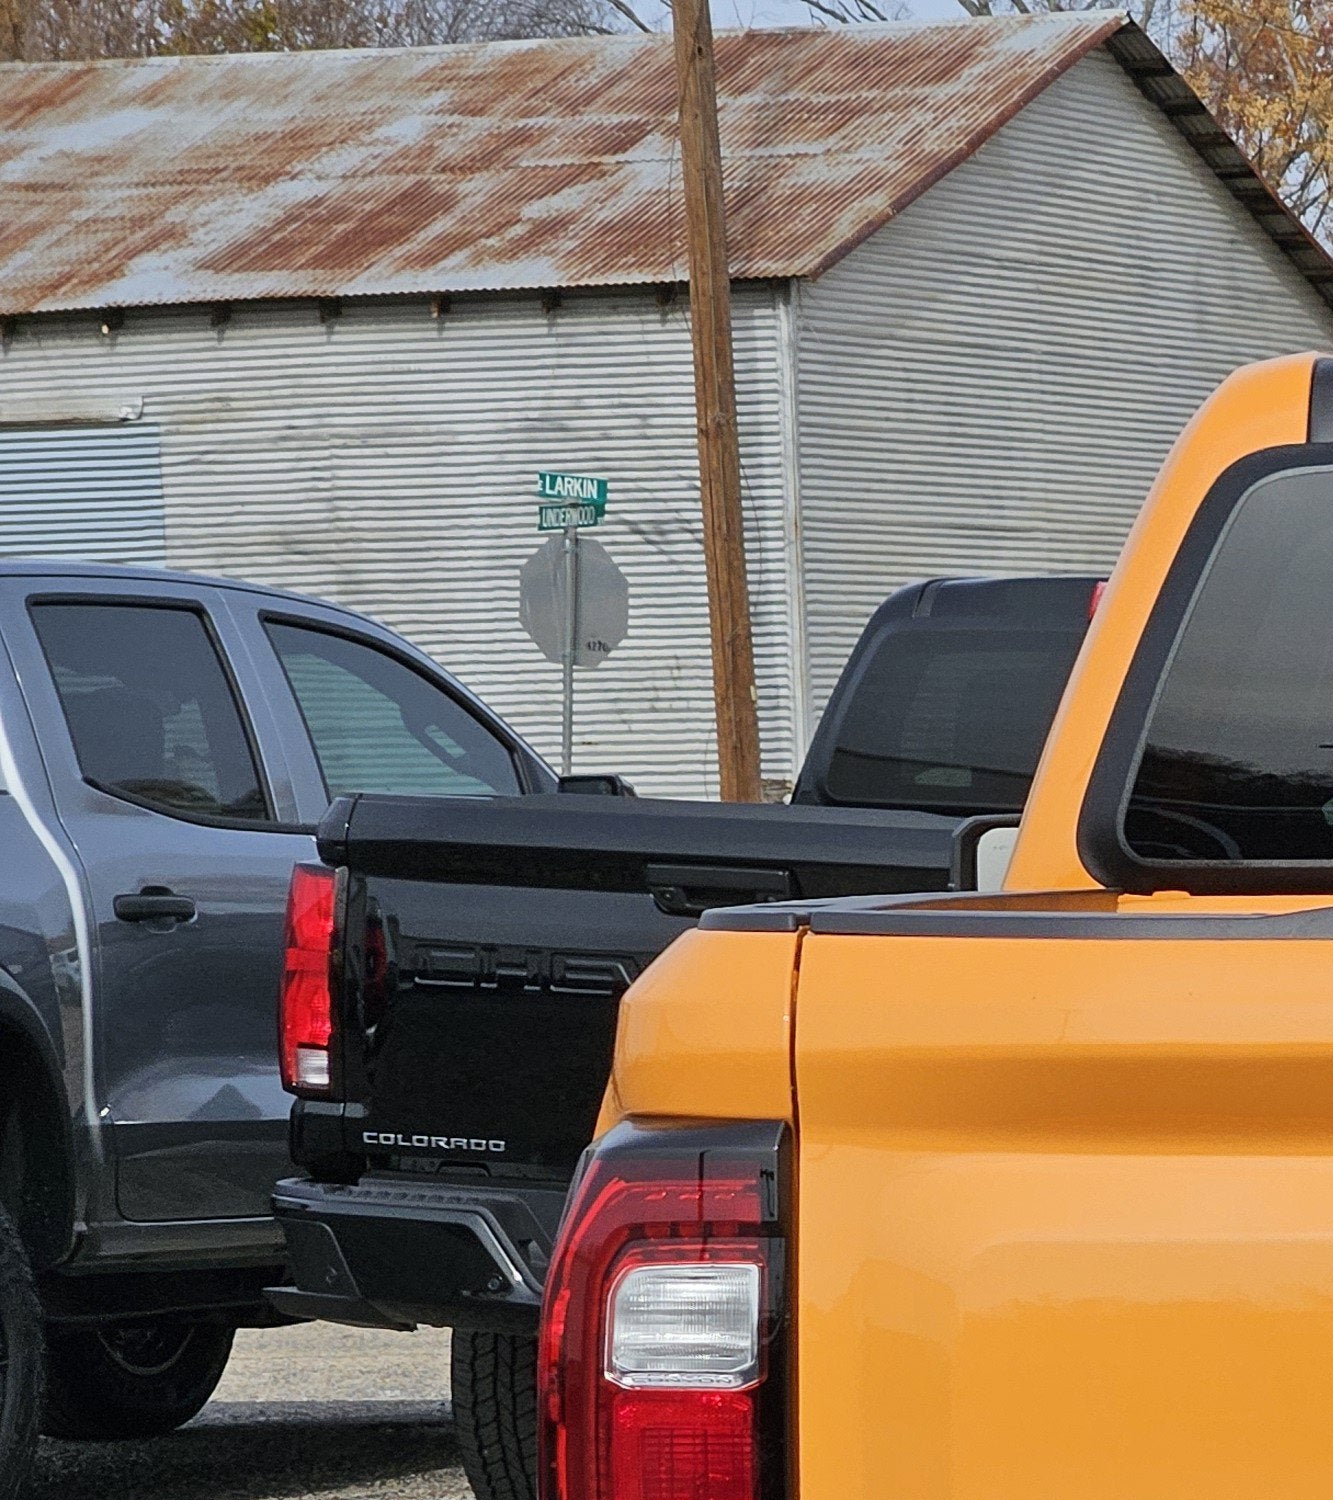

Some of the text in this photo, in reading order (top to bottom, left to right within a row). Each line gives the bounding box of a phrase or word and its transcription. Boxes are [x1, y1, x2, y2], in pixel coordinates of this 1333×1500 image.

[545, 474, 598, 499] LARKIN
[542, 506, 595, 527] UNDERWOOD
[362, 1131, 506, 1151] COLORADO
